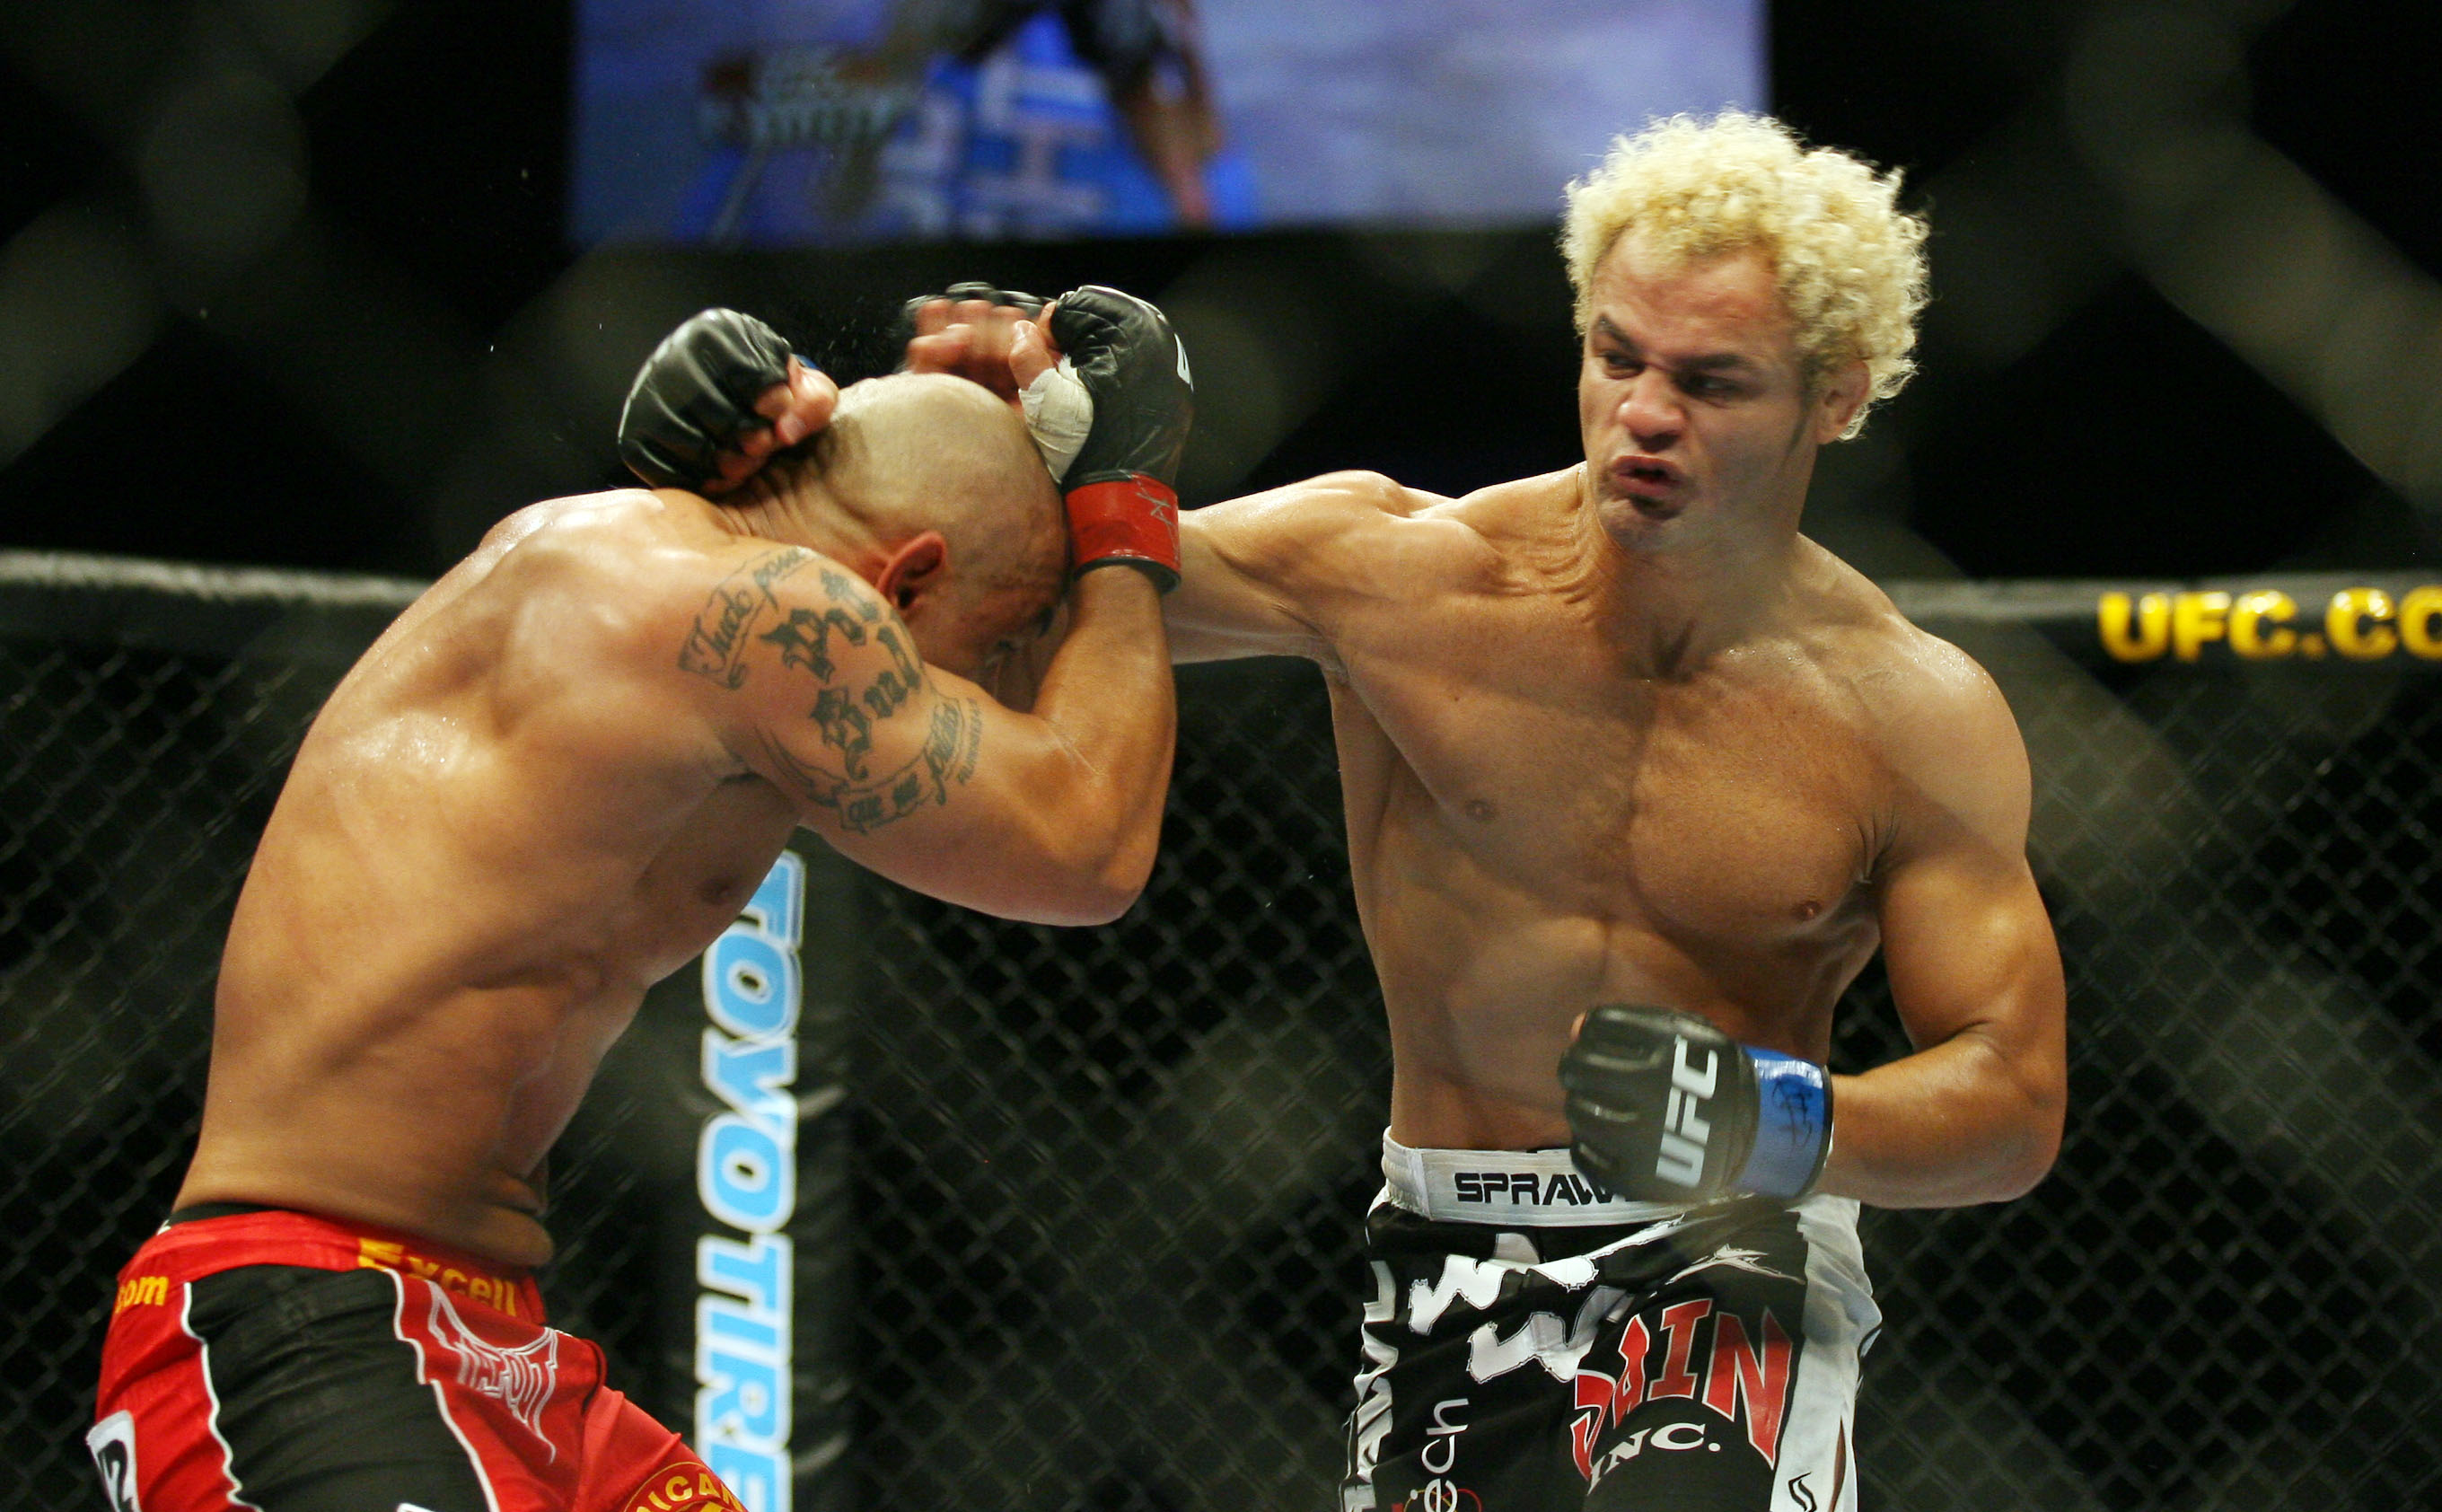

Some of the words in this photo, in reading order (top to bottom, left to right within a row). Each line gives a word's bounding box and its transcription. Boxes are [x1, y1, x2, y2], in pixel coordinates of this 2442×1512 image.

[1656, 1034, 1718, 1188] UFC
[1454, 1172, 1645, 1206] SPRAW
[1586, 1422, 1722, 1497] INC.
